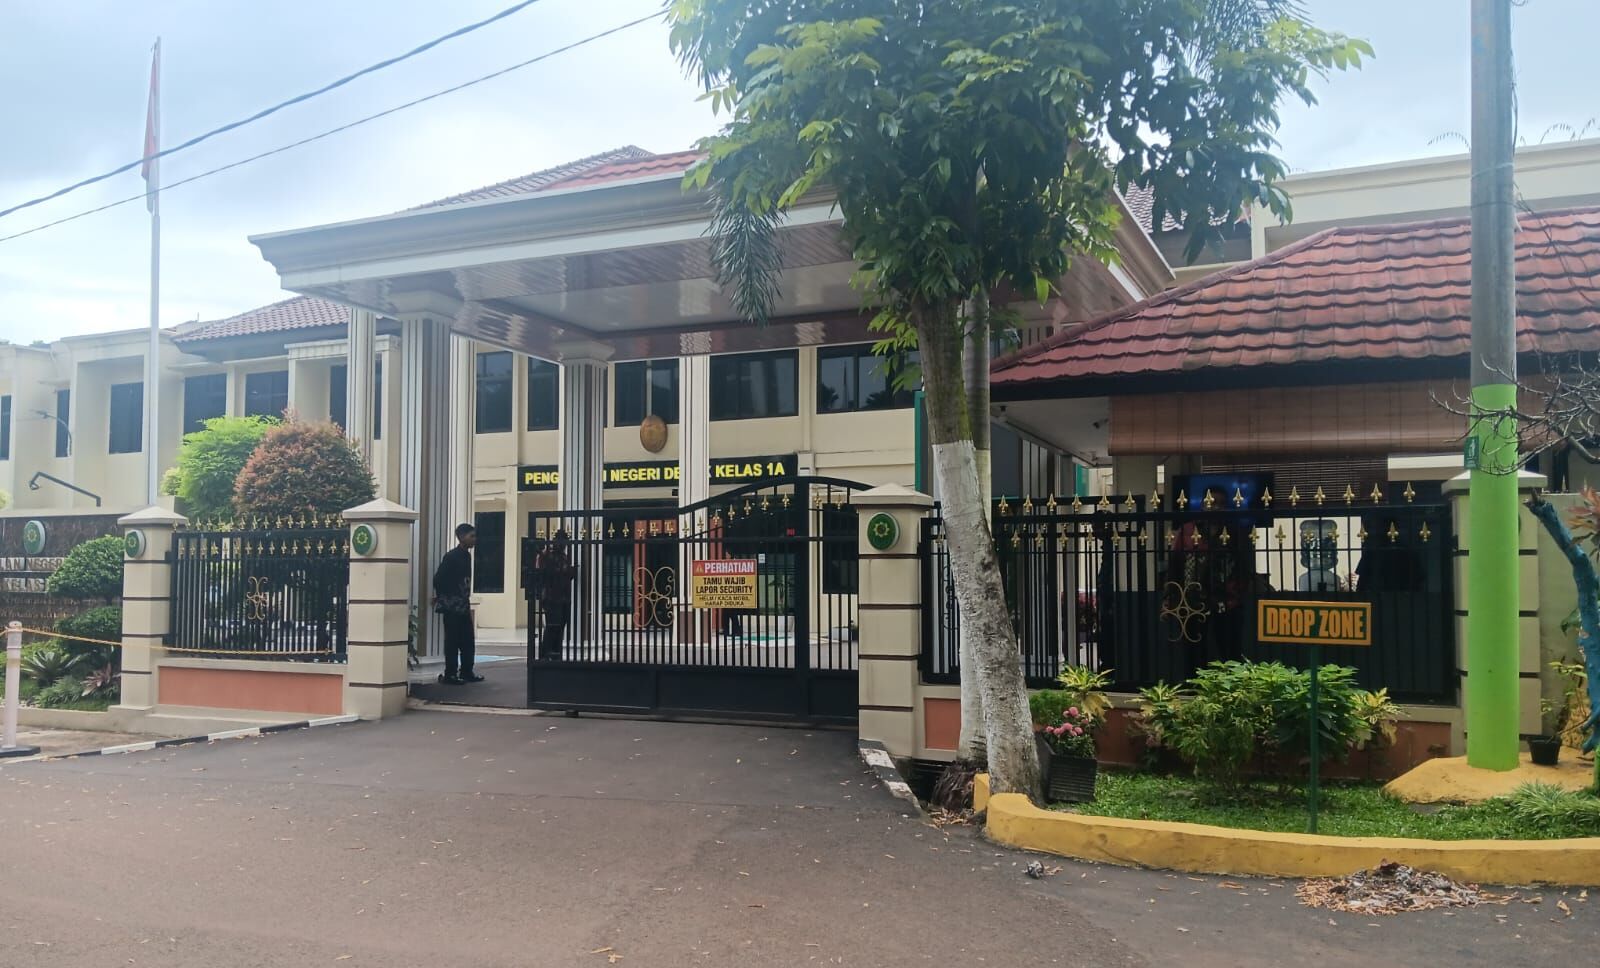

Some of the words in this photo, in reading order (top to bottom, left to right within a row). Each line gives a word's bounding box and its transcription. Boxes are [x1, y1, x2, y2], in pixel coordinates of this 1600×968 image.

[611, 467, 660, 482] NEGERI
[715, 463, 762, 477] KELAS
[767, 462, 785, 475] 1A
[704, 562, 754, 573] PERHATIAN
[720, 585, 753, 593] SECURITY
[1266, 607, 1315, 636] DROP
[1319, 609, 1363, 638] ZONE
